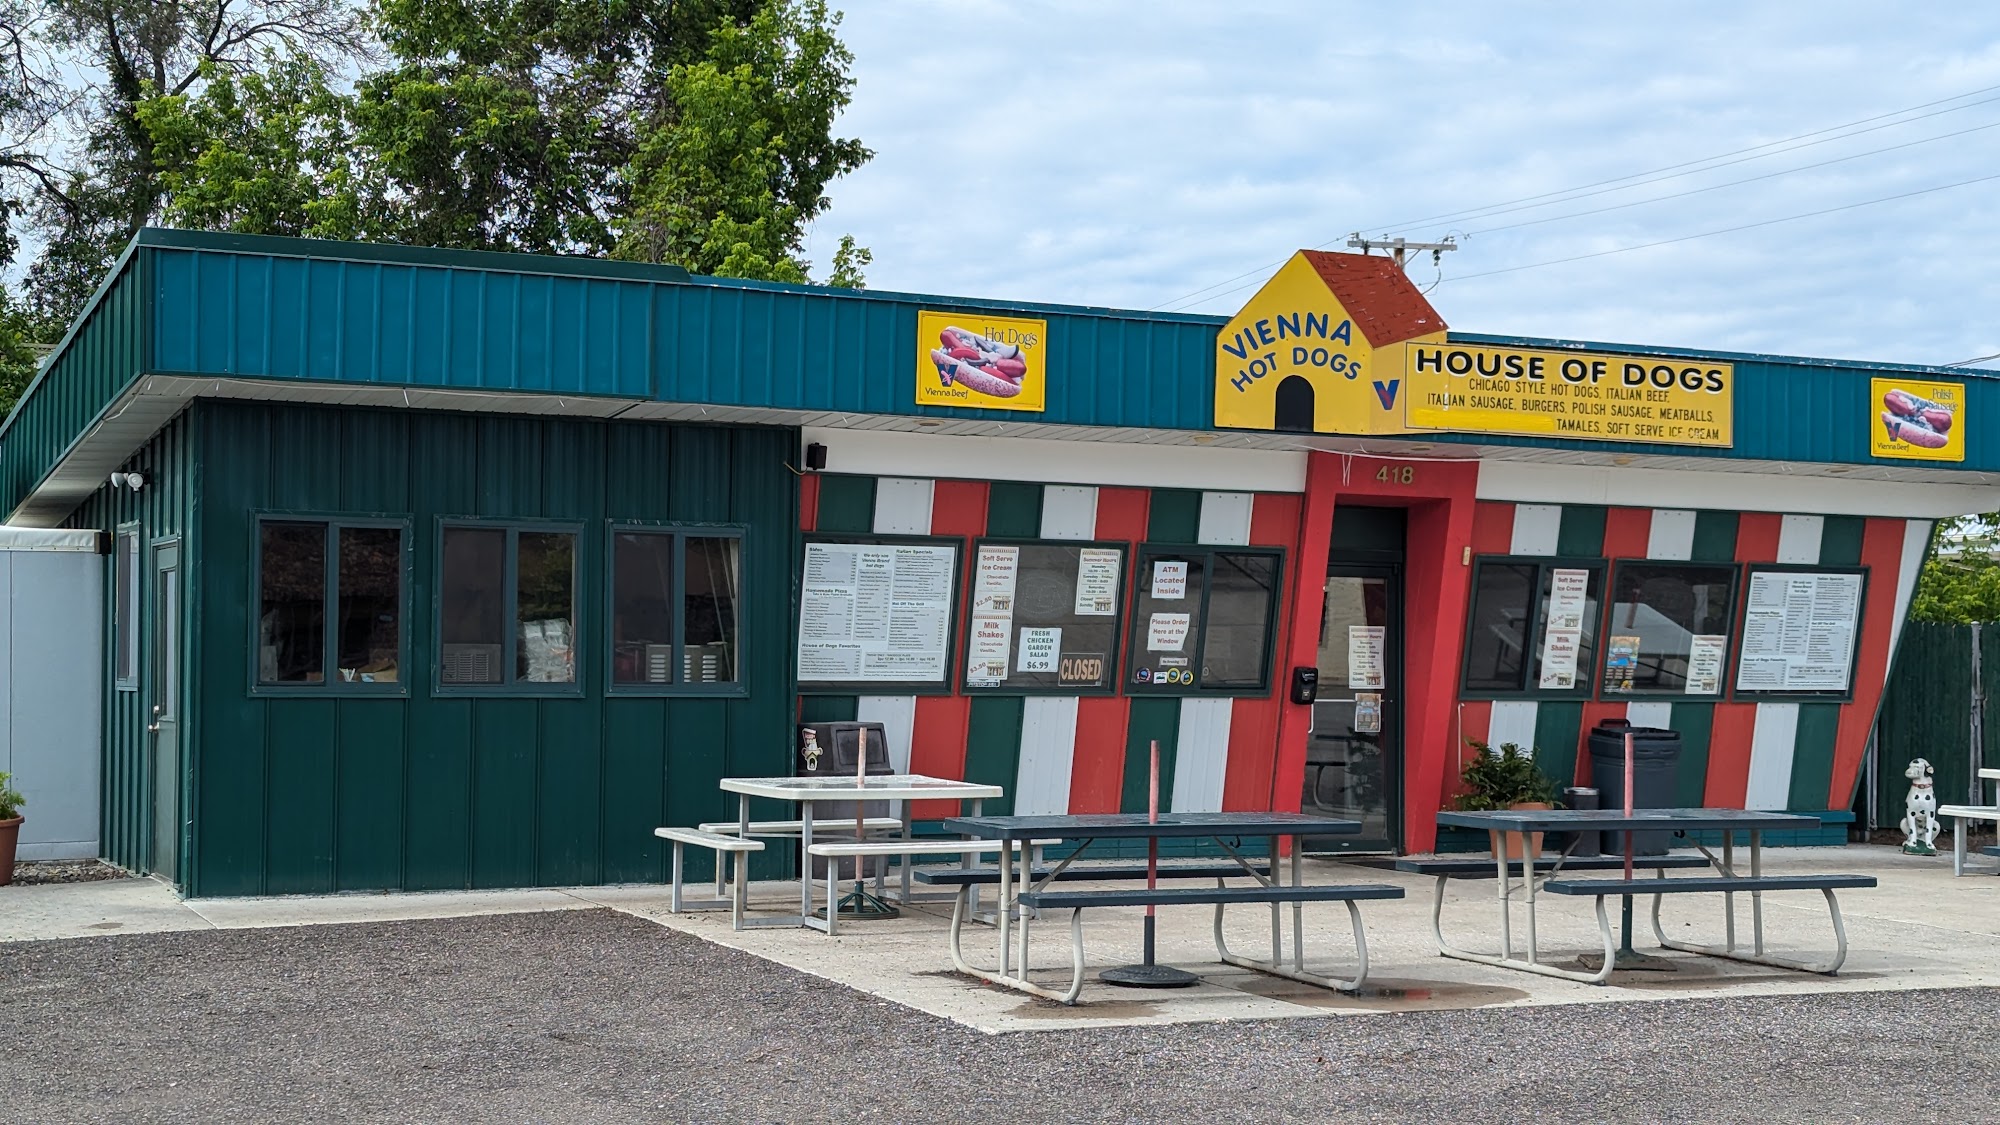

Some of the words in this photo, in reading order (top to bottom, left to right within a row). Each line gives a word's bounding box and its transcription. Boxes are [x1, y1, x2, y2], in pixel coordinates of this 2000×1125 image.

[985, 326, 1005, 343] Hot
[1008, 328, 1038, 349] Dogs
[1222, 311, 1351, 360] VIENNA
[1230, 351, 1276, 393] HOT
[1292, 346, 1362, 380] DOGS
[1415, 349, 1545, 382] HOUSE
[1560, 359, 1607, 384] OF
[1622, 363, 1724, 395] DOGS
[925, 387, 951, 397] Vienna
[952, 389, 969, 400] Beef
[1469, 378, 1510, 392] CHICAGO
[1515, 381, 1546, 395] STYLE
[1551, 383, 1568, 396] HOT
[1606, 387, 1642, 401] ITALIAN
[1932, 388, 1954, 400] Polish
[1427, 393, 1465, 407] ITALIAN
[1572, 402, 1606, 416] POLISH
[1606, 422, 1629, 435] SOFT
[1634, 424, 1664, 438] SERVE
[1669, 426, 1682, 437] ICE
[1688, 428, 1719, 440] CREAM
[1376, 465, 1414, 484] 418
[984, 621, 1000, 629] Milk
[1551, 644, 1573, 652] Shakes
[1026, 660, 1049, 670] $6.99
[1061, 658, 1102, 680] CLOSED
